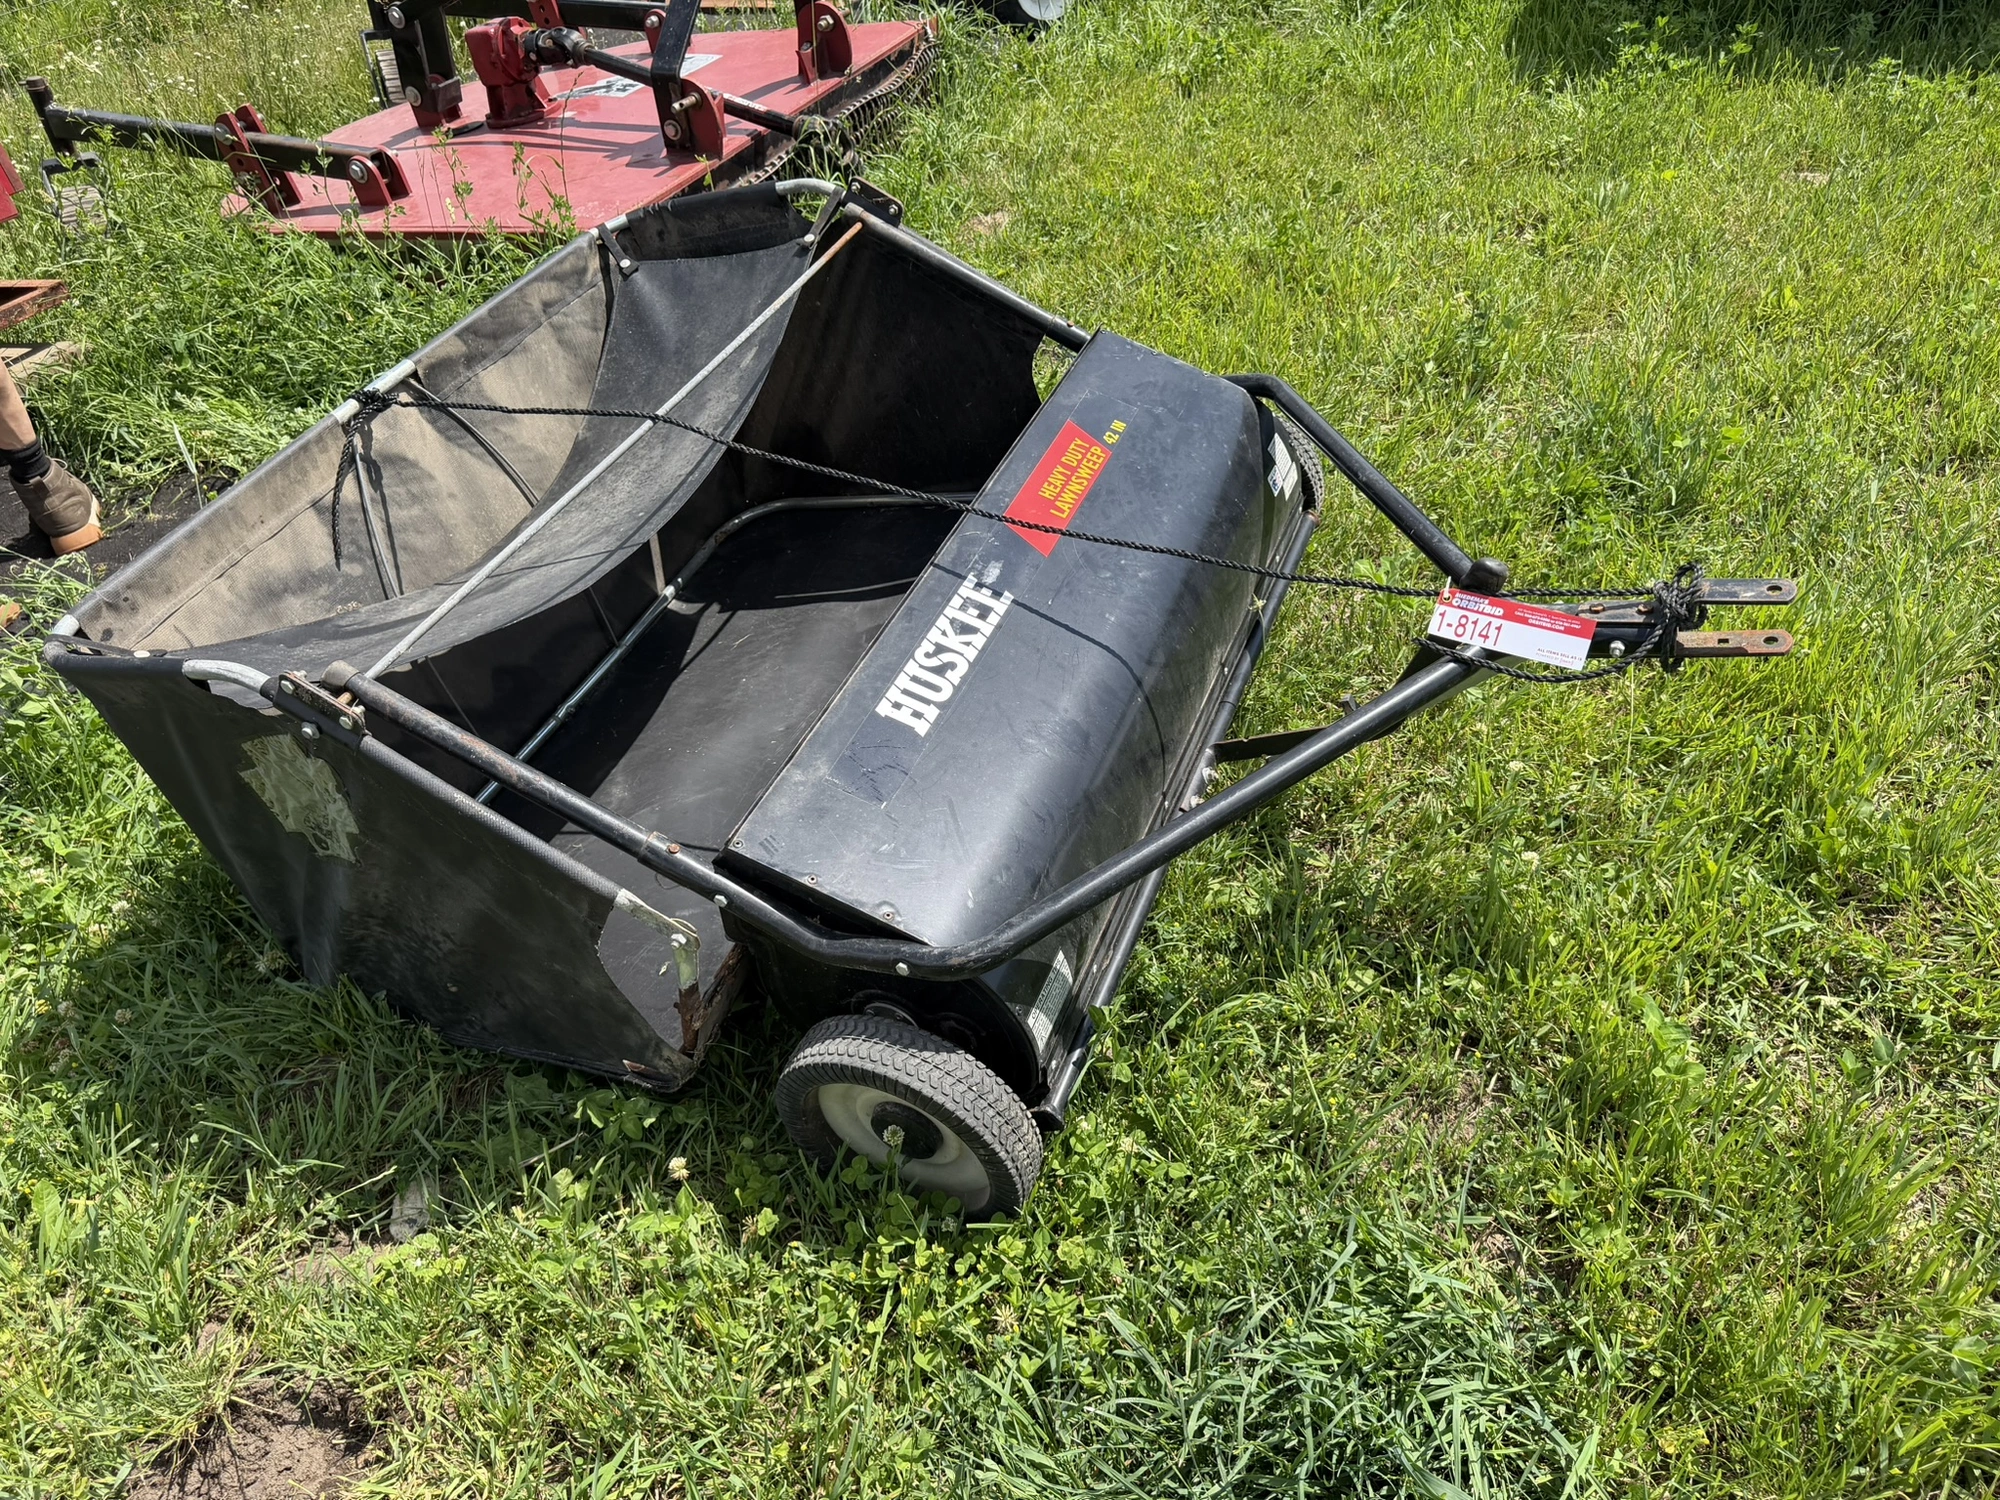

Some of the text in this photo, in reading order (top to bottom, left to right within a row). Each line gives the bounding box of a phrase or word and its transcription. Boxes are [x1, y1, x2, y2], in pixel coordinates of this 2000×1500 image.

[1103, 419, 1127, 445] 42 IN
[1038, 438, 1089, 500] HEAVY DUTY
[1049, 446, 1106, 519] LAWNSWEEP
[1437, 609, 1503, 646] 1-8141
[1452, 598, 1504, 617] ORBITBID
[1527, 618, 1565, 631] ORBITBID.COM
[875, 572, 1014, 738] HUSKEE
[1032, 977, 1053, 1020] OPERATING
